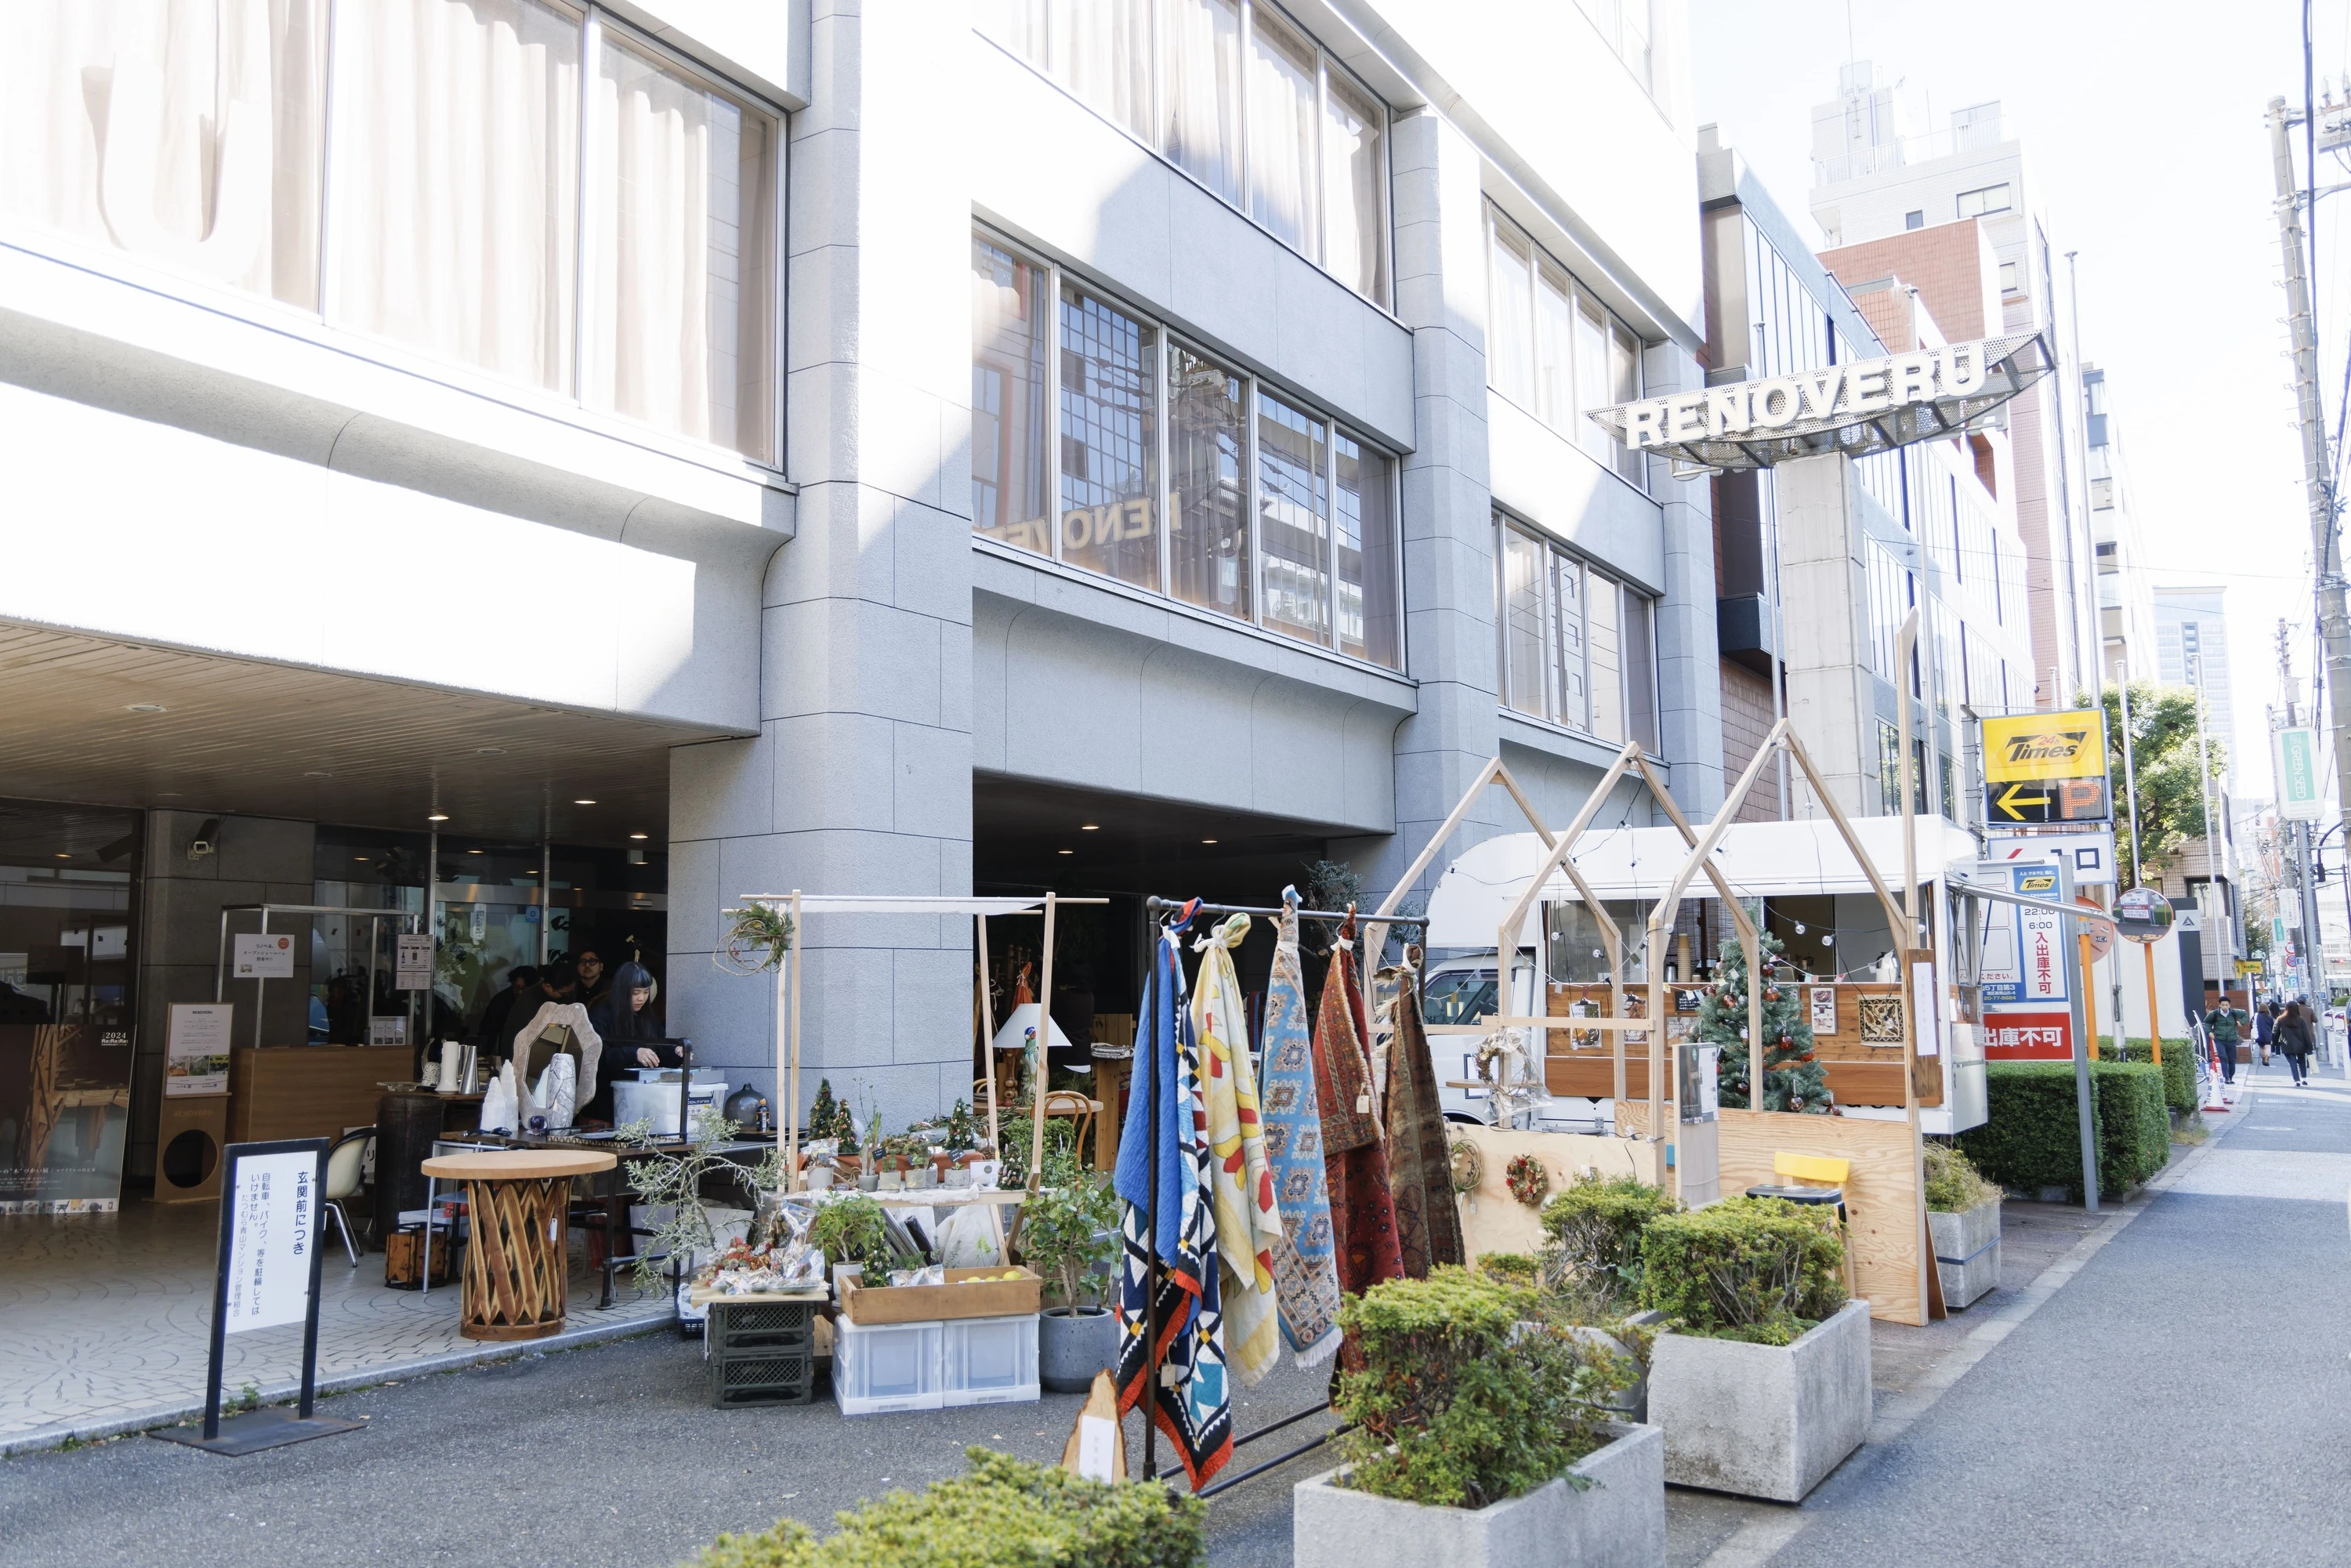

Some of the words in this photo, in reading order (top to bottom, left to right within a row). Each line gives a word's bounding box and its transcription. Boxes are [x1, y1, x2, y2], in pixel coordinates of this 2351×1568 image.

[1626, 342, 1987, 450] RENOVERU
[2005, 731, 2088, 762] Times
[2291, 745, 2304, 775] GREEN
[2063, 780, 2099, 818] P
[2295, 776, 2306, 799] SEED
[2025, 878, 2052, 889] Times
[2035, 932, 2052, 994] 入出庫不可
[248, 1174, 260, 1227] いけません。
[293, 1171, 309, 1255] 玄関前につき
[233, 1194, 249, 1317] たつむら青山マンション管理組合
